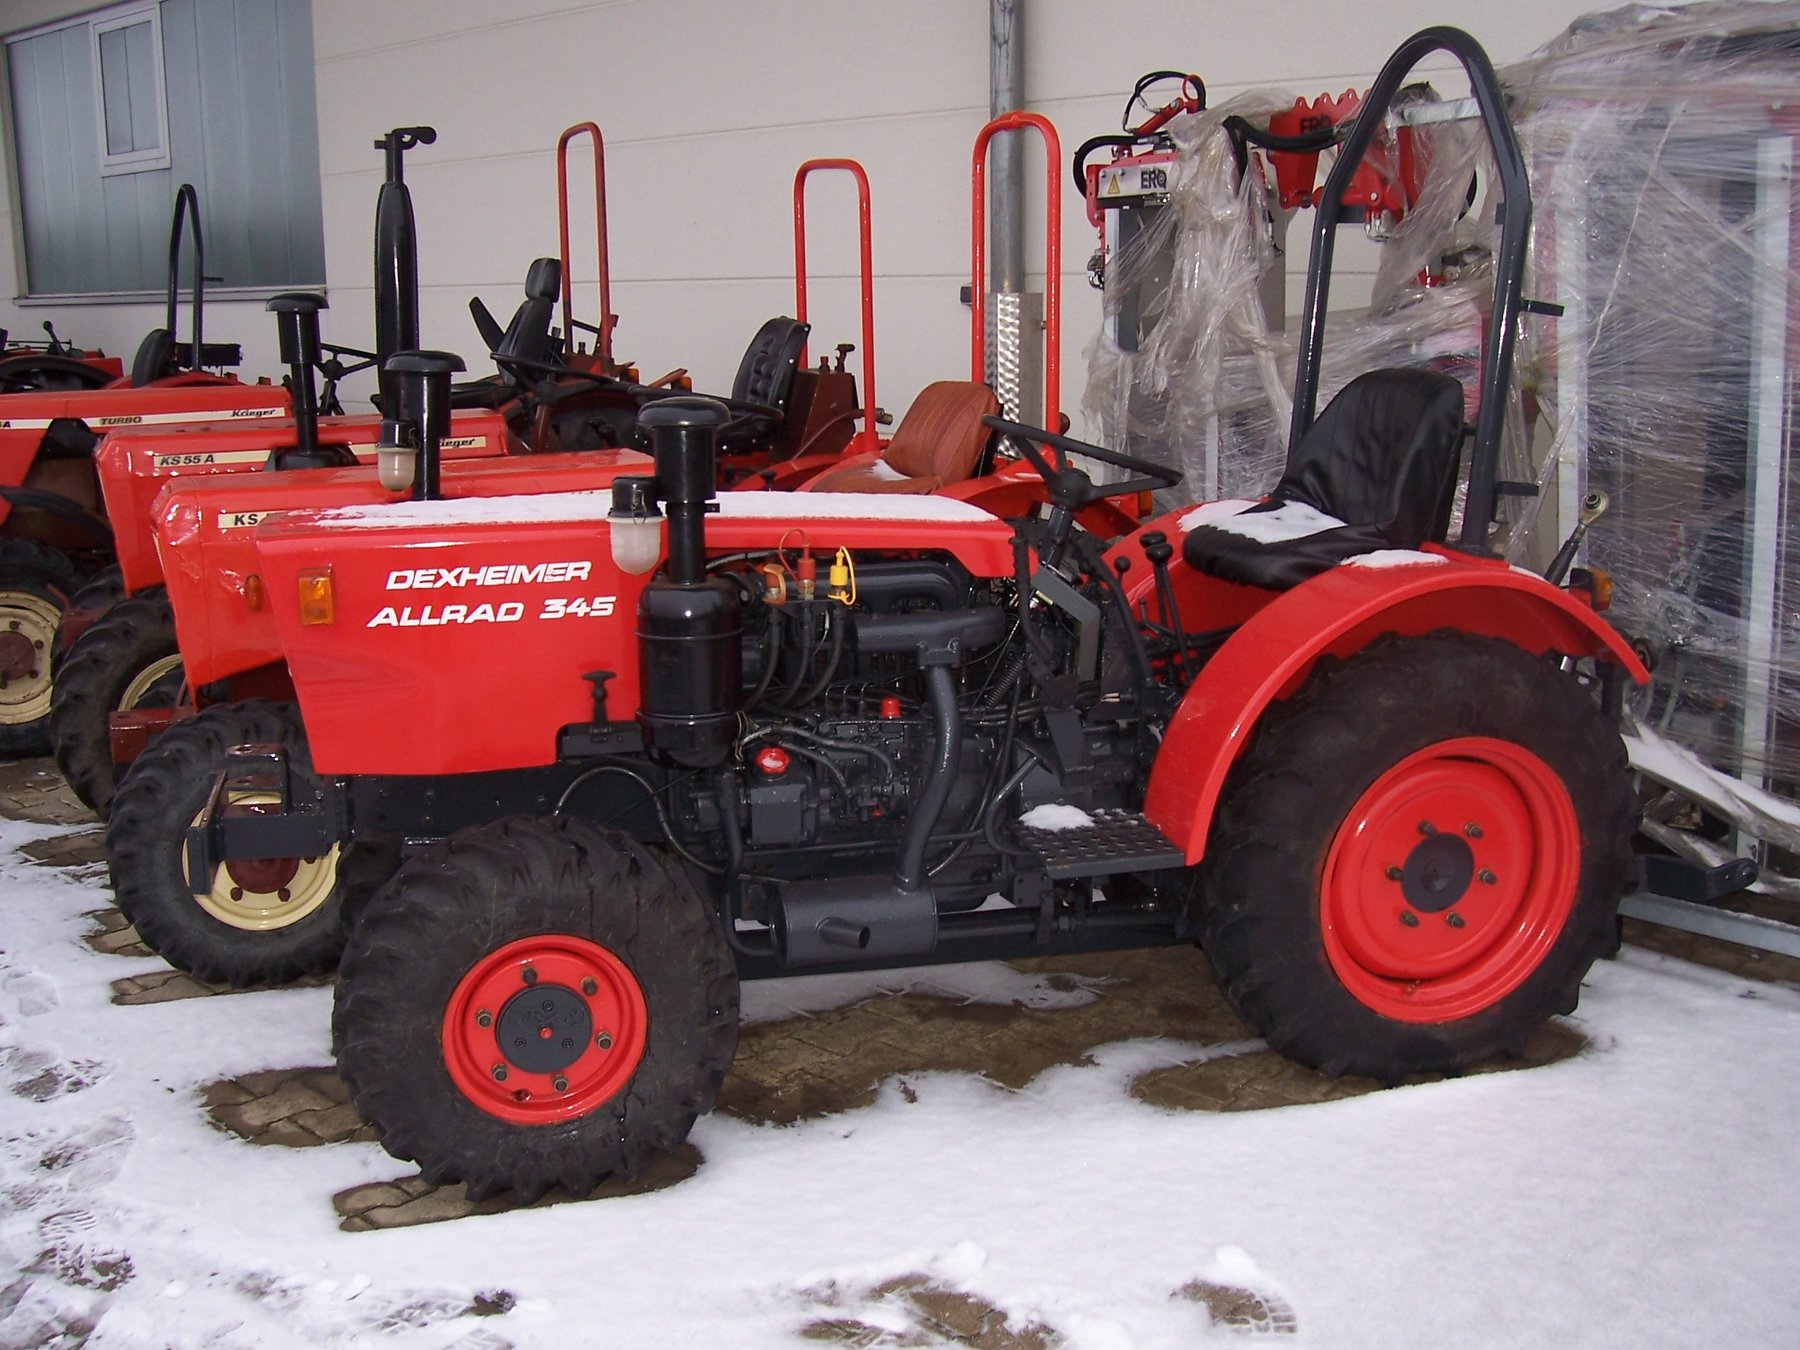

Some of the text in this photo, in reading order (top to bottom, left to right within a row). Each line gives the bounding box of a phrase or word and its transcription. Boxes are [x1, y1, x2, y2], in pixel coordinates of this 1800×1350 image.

[100, 416, 143, 426] TURBO
[230, 408, 276, 419] Krieger
[160, 455, 181, 466] KS
[203, 454, 215, 464] A
[439, 438, 476, 449] ieger
[233, 513, 259, 527] KS
[385, 560, 592, 591] DEXHEIMER
[366, 595, 618, 628] ALLRAD 345
